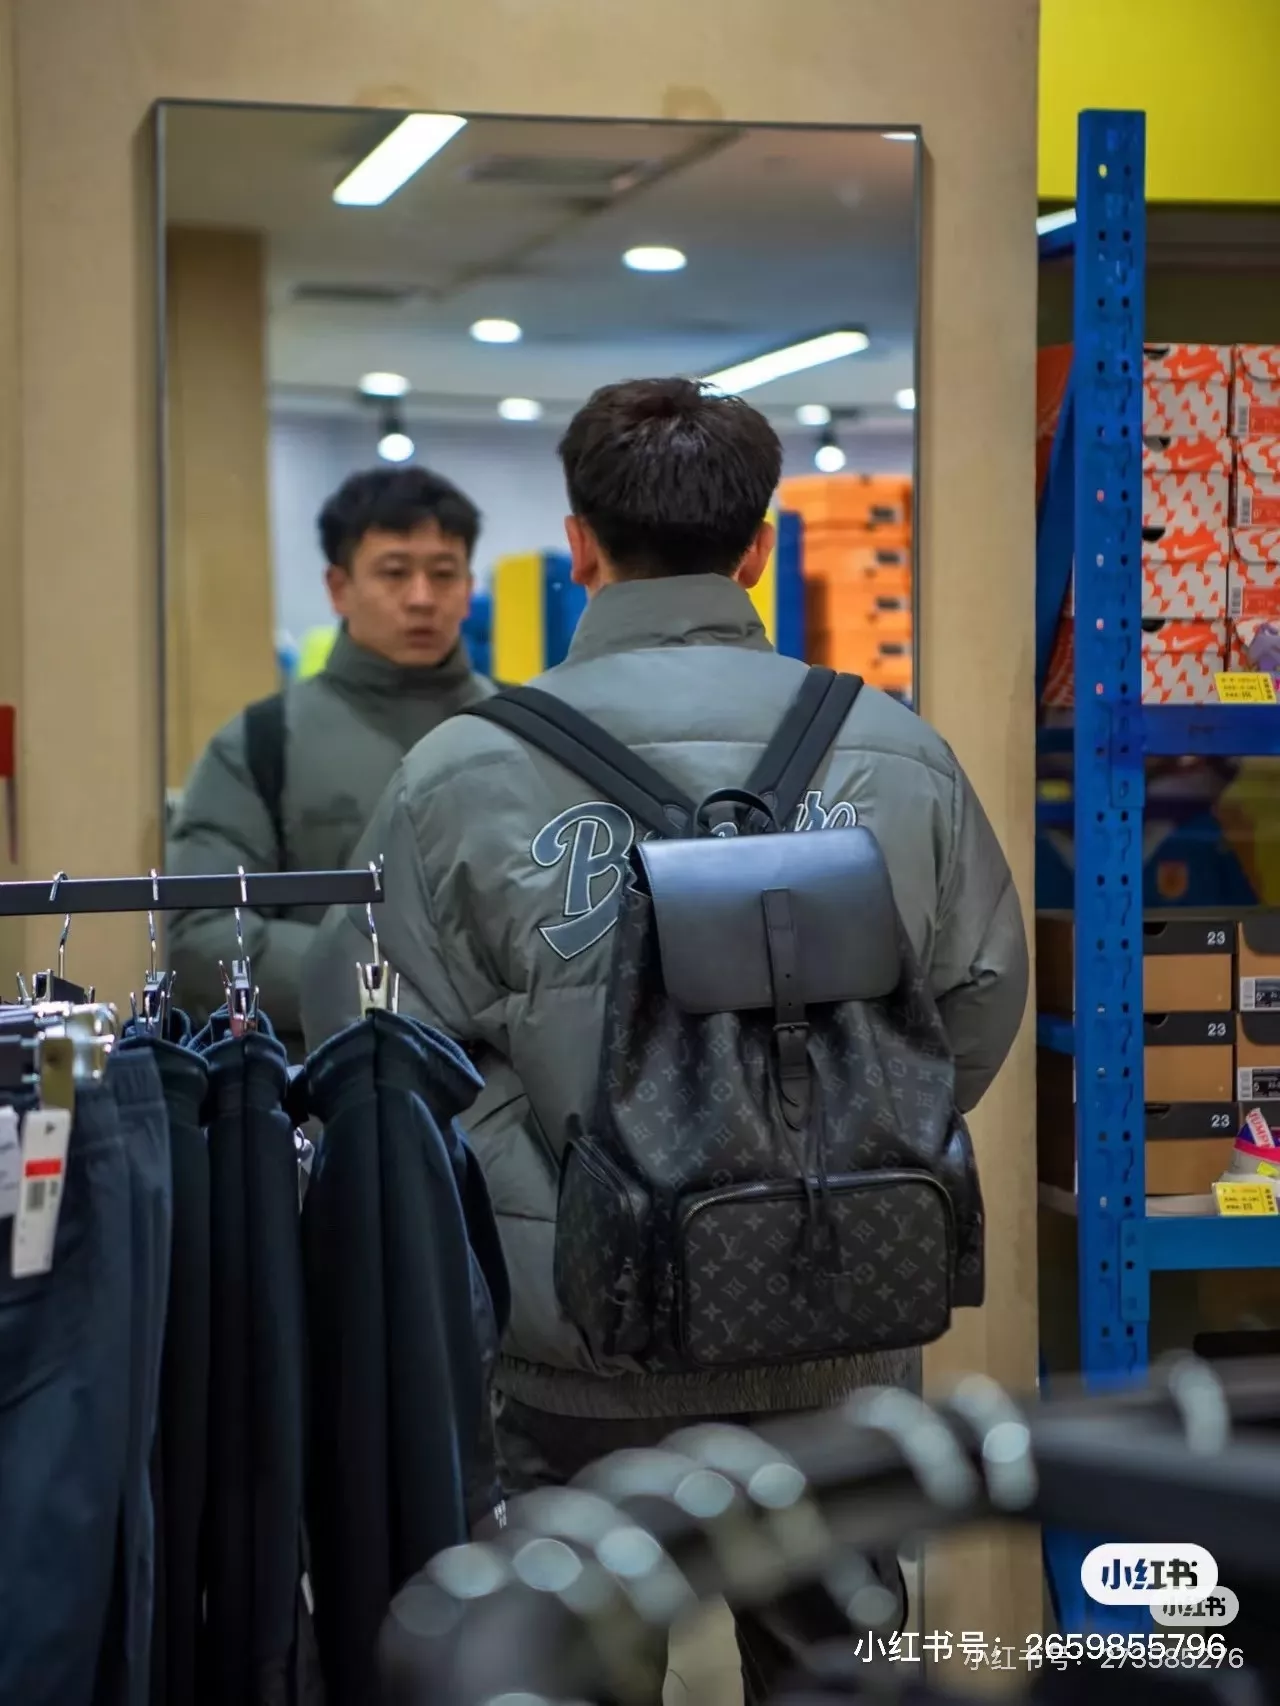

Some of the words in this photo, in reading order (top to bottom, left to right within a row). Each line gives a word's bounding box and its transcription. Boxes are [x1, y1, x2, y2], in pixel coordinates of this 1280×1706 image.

[1207, 931, 1226, 946] 23
[1207, 1022, 1227, 1037] 23
[1211, 1114, 1230, 1128] 23
